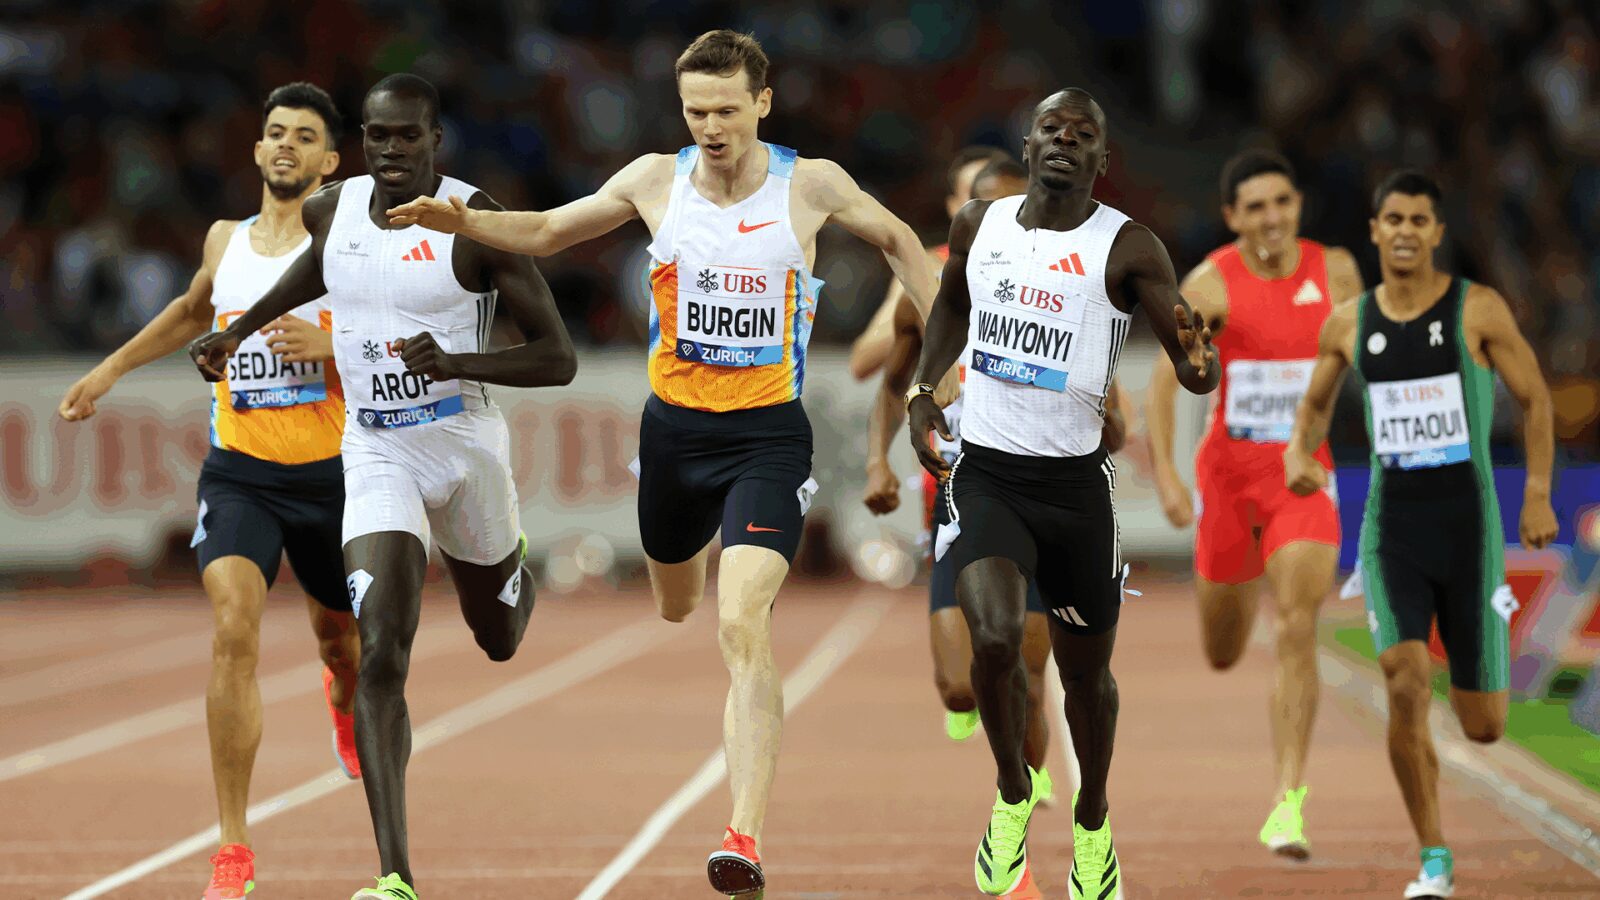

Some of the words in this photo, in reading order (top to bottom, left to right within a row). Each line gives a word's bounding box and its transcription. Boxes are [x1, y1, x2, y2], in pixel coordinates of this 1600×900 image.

[723, 273, 767, 294] UBS
[1019, 286, 1065, 313] UBS
[687, 301, 776, 338] BURGIN
[978, 310, 1073, 362] WANYONYI
[701, 346, 755, 363] ZURICH
[987, 357, 1038, 381] ZURICH
[247, 389, 298, 405] ZURICH
[372, 370, 434, 402] AROP
[382, 406, 436, 426] ZURICH
[1379, 408, 1463, 444] ATTAOUI
